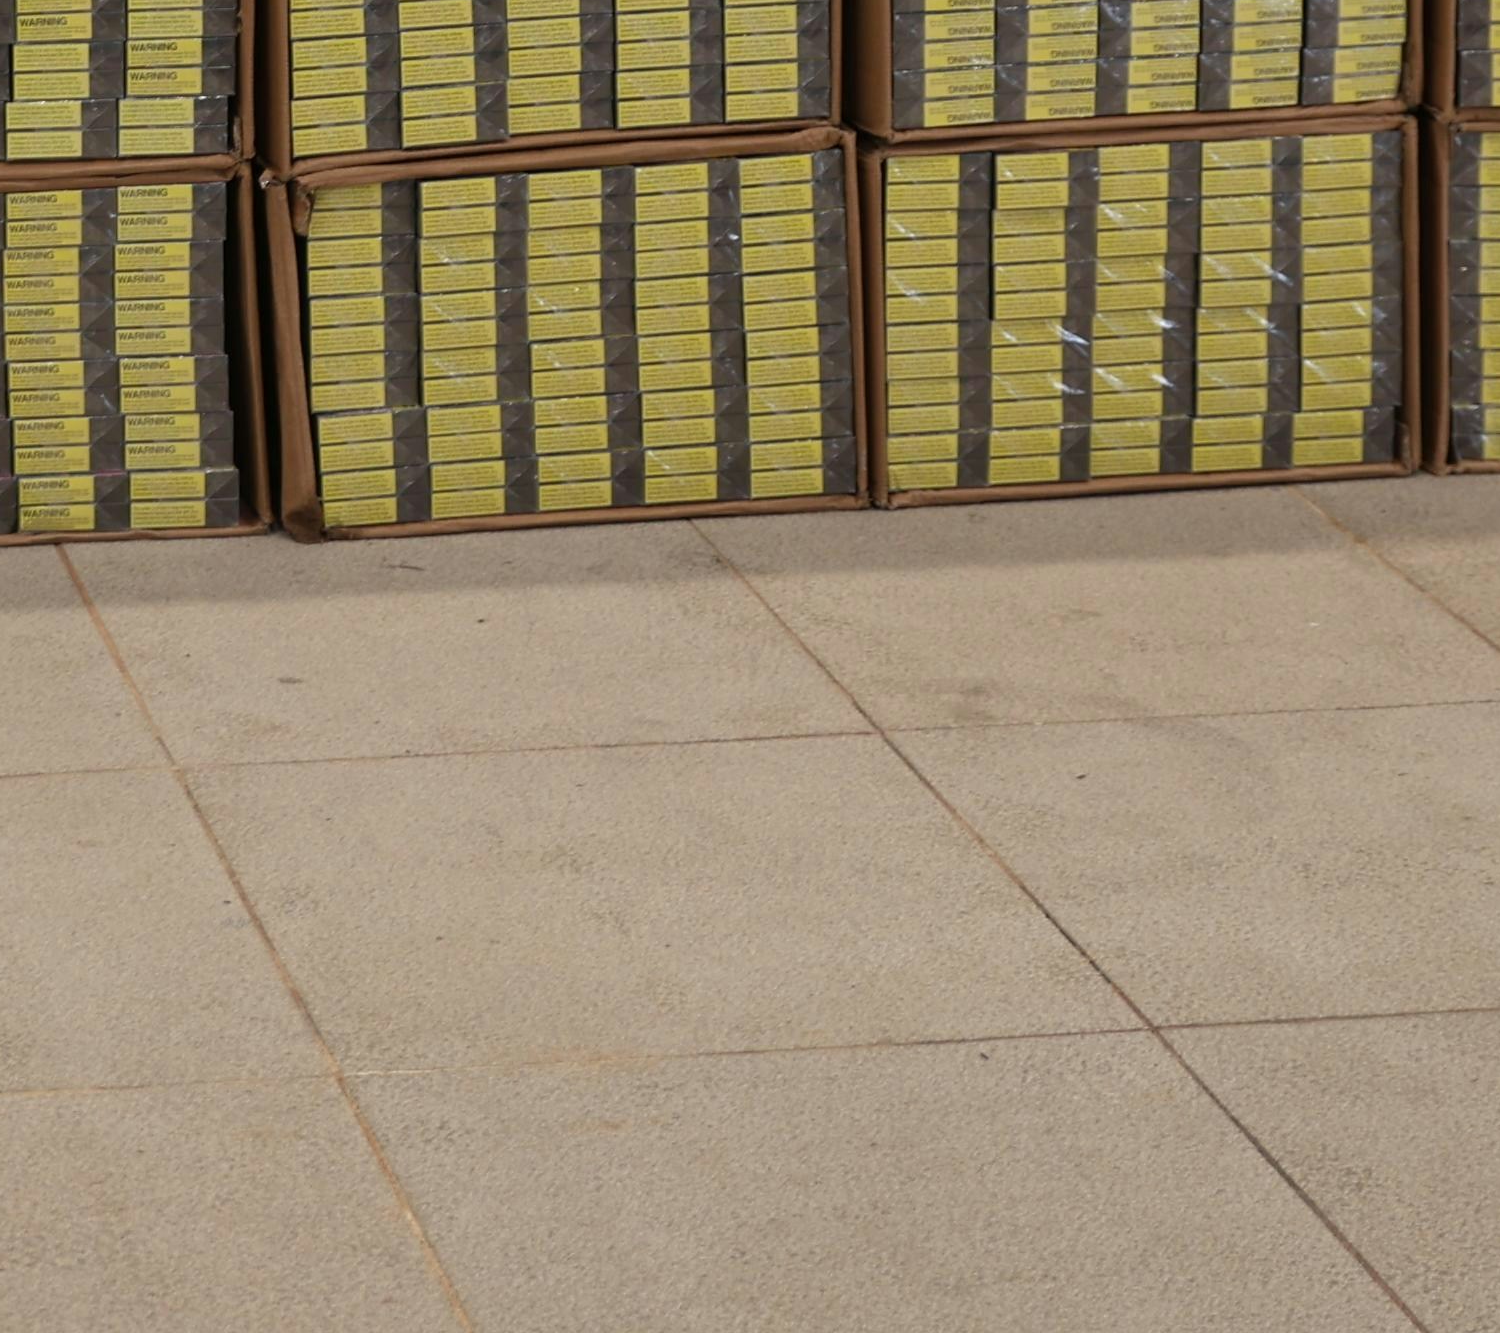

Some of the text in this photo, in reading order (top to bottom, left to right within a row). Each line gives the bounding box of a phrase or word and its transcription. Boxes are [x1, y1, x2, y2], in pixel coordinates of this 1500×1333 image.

[20, 17, 69, 26] WARNING
[130, 42, 179, 51] WARNING
[130, 71, 179, 80] WARNING
[121, 187, 169, 197] WARNING
[12, 364, 60, 374] WARNING
[13, 392, 61, 402] WARNING
[18, 449, 66, 459] WARNING
[22, 479, 70, 489] WARNING
